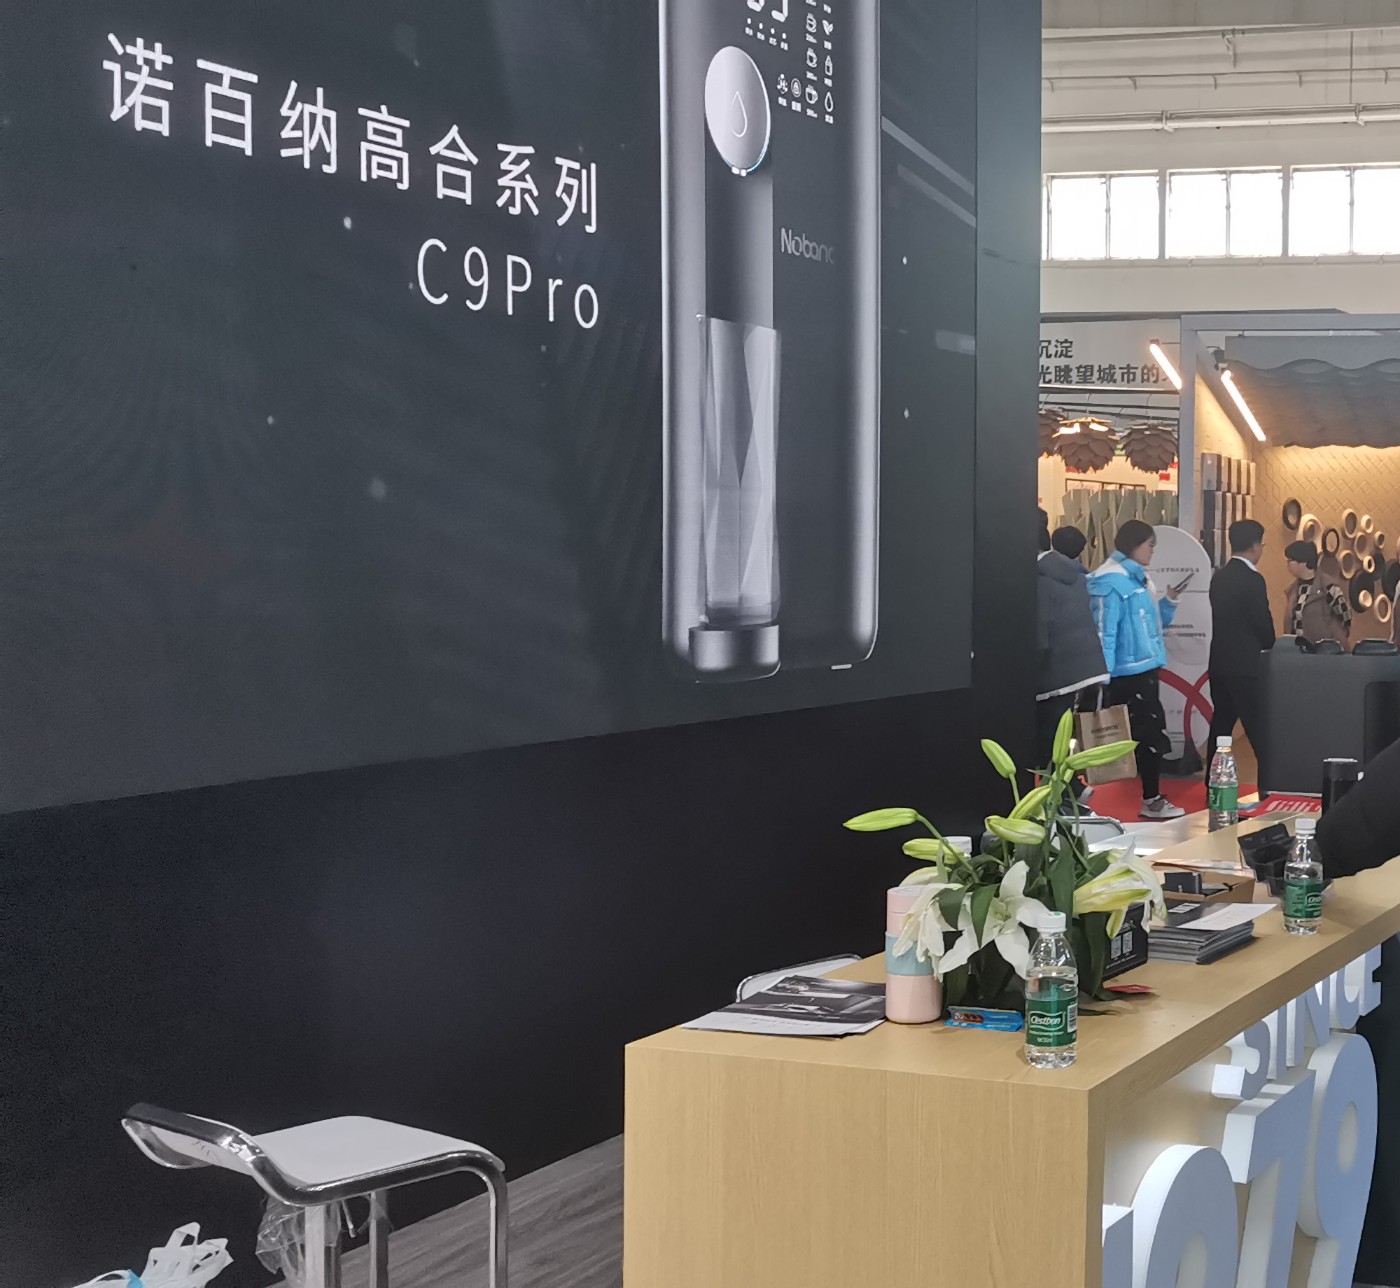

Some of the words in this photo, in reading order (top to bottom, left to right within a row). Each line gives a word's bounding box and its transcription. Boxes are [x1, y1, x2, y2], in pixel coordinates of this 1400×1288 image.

[102, 33, 598, 234] 诺百纳高合系列
[416, 238, 600, 329] C9Pro
[1039, 363, 1169, 385] 光眺望城市的
[1211, 944, 1382, 1101] SINCE
